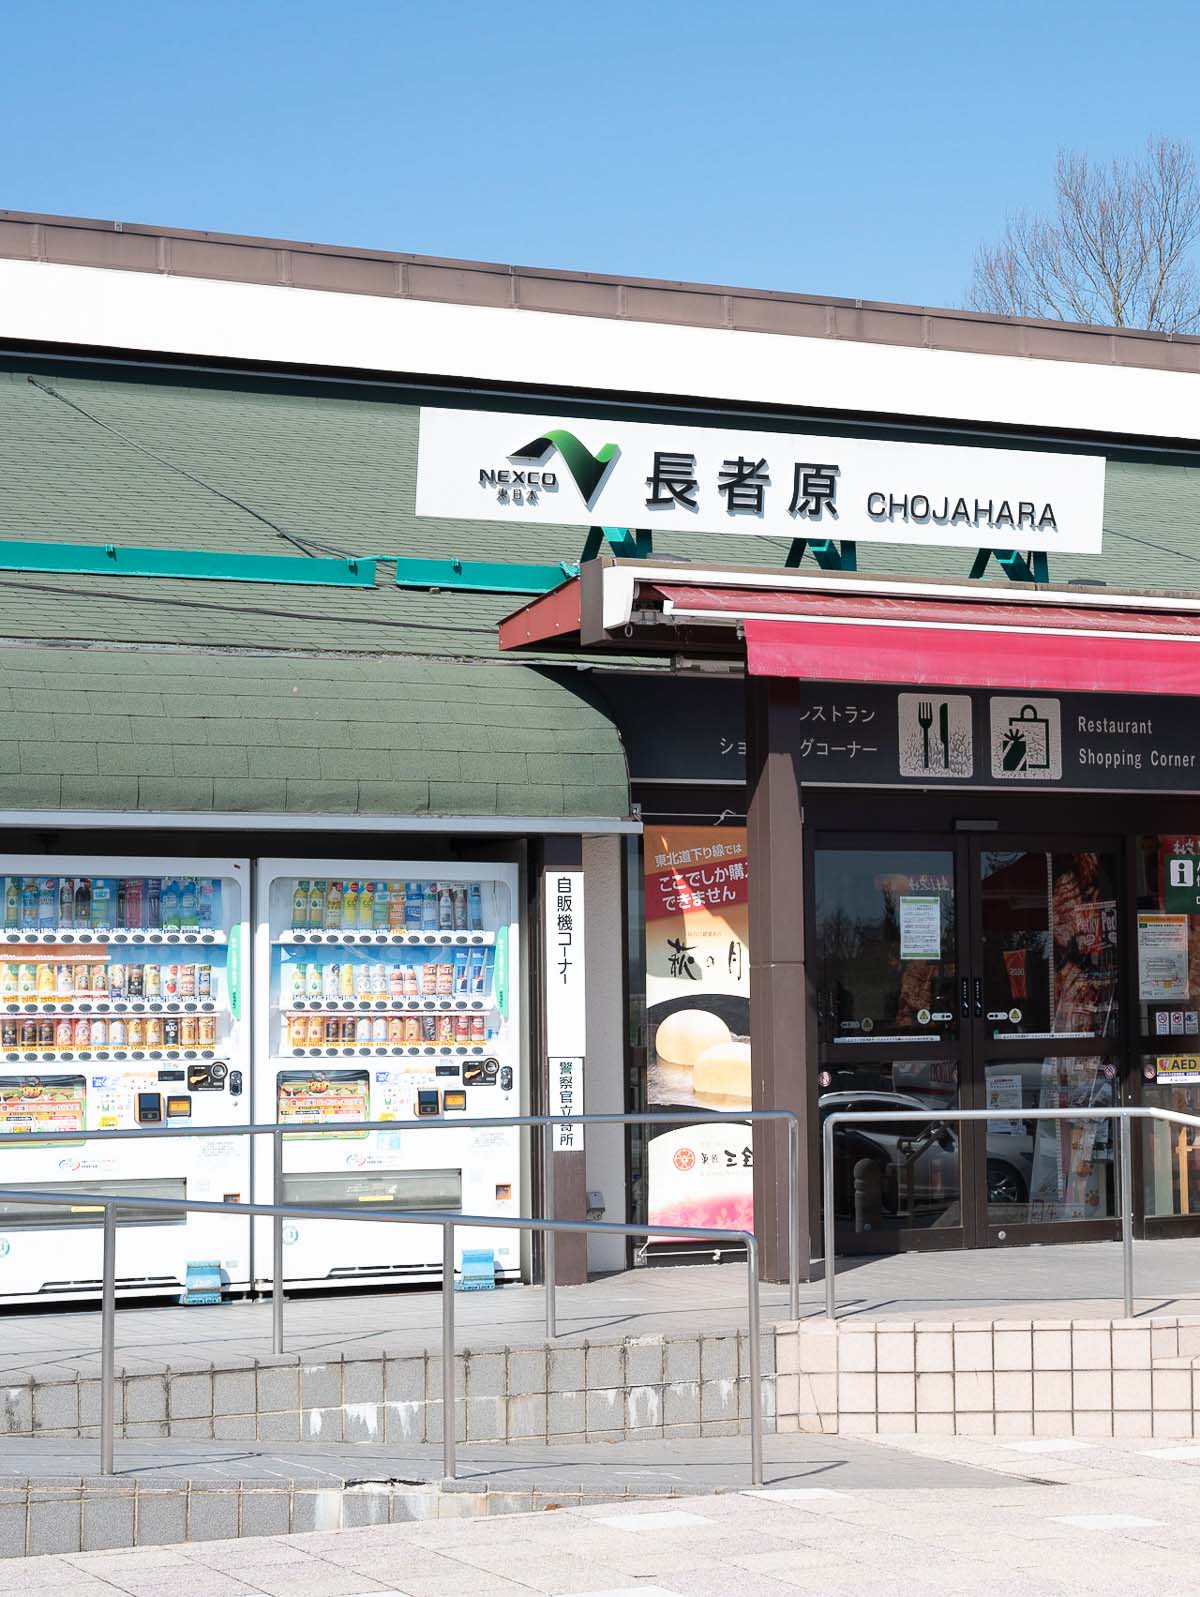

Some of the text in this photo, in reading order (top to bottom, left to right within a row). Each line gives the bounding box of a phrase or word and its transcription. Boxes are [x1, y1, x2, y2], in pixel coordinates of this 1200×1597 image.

[479, 469, 557, 486] NEXCO
[645, 451, 840, 516] 長者原
[866, 491, 1058, 529] CHOJAHARA
[1078, 715, 1153, 735] Restaurant
[1079, 748, 1196, 769] Shopping Corner
[655, 843, 742, 867] 東北道下り線では
[662, 886, 736, 911] できません
[557, 877, 573, 985] 自販機コーナー
[1171, 1059, 1197, 1070] AED
